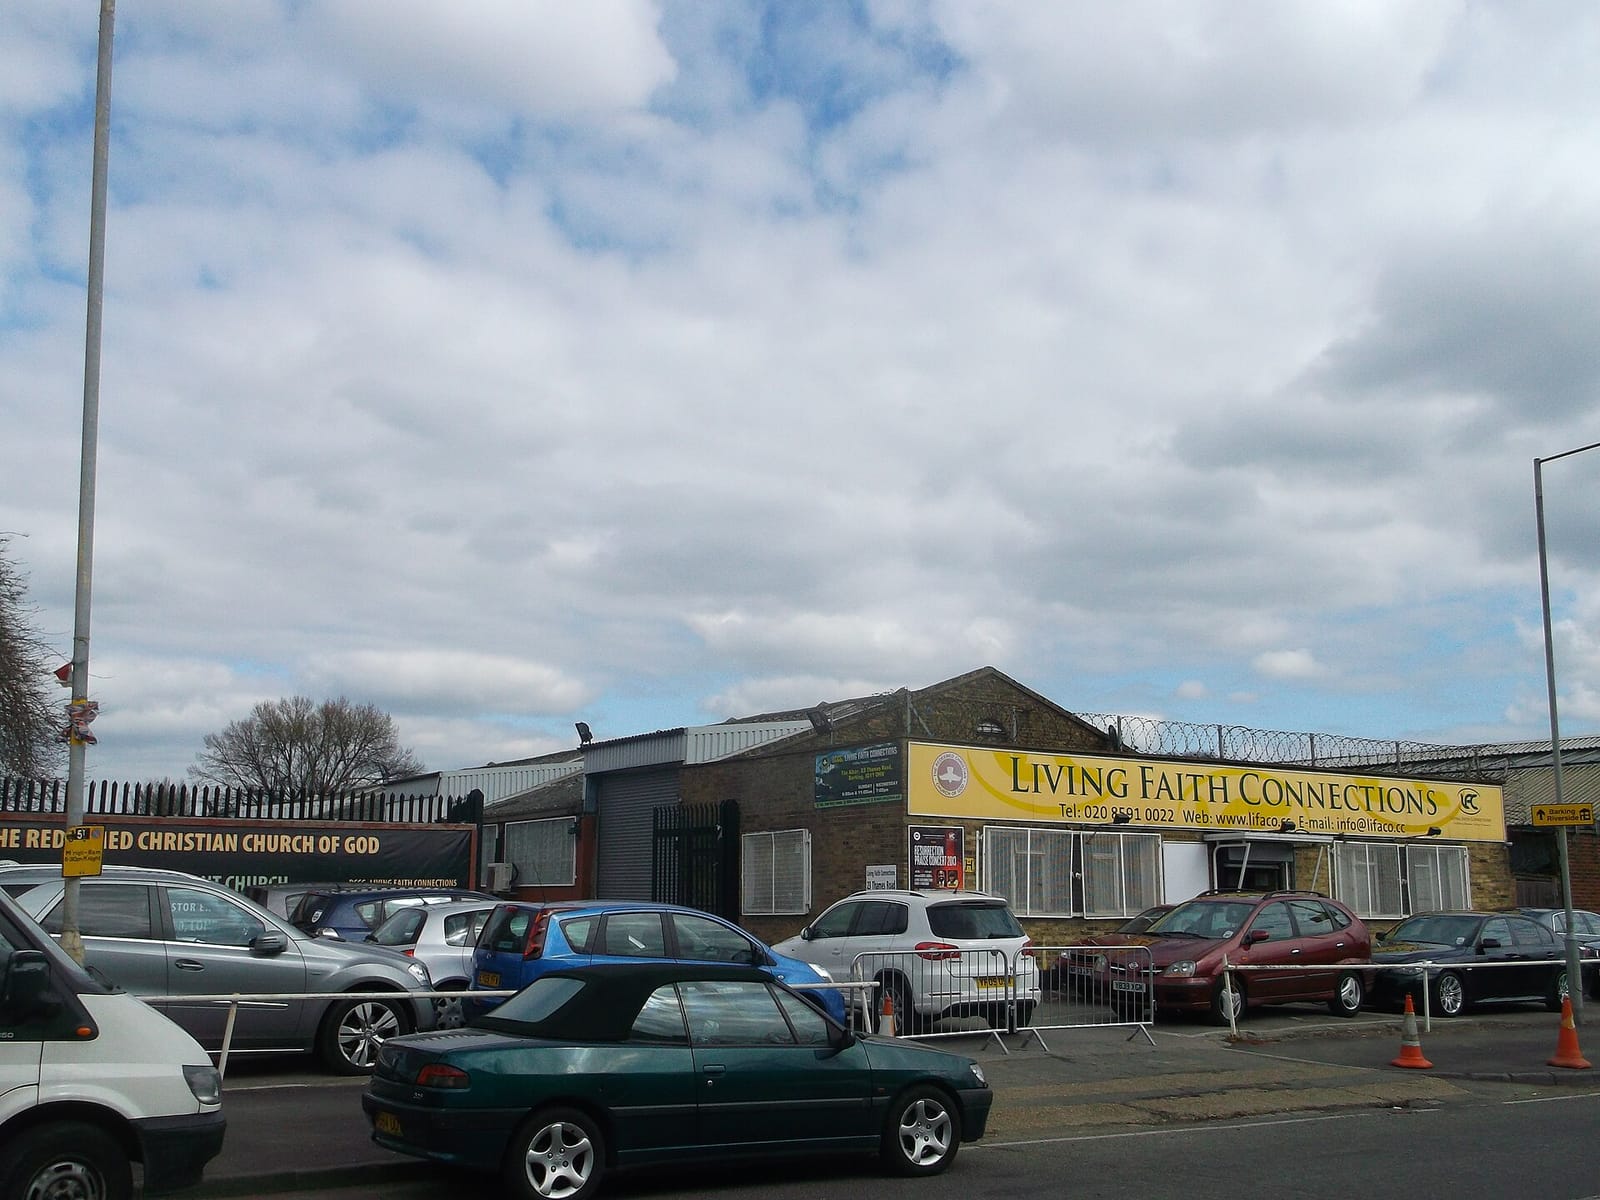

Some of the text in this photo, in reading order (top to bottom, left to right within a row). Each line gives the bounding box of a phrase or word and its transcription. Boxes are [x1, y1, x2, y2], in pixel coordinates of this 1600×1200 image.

[844, 753, 857, 762] LIVING
[858, 751, 869, 760] FAITH
[870, 746, 898, 758] CONNECTIONS
[1010, 757, 1438, 816] LIVING FAITH CONNECTIONS
[1059, 803, 1081, 818] Tel:
[1084, 805, 1108, 820] 020
[1145, 808, 1174, 823] 0022
[1183, 809, 1213, 824] Web:
[1299, 815, 1335, 830] E-mail:
[1336, 817, 1405, 833] info@lifaco.cc
[1549, 808, 1576, 816] Barking
[0, 828, 21, 848] HE
[137, 831, 238, 852] CHRISTIAN
[242, 834, 315, 853] CHURCH
[318, 835, 340, 854] OF
[344, 836, 380, 855] GOD
[914, 844, 944, 856] RESURRECTION
[914, 855, 929, 867] PRAISE
[929, 855, 947, 867] CONCERT
[965, 858, 974, 873] H
[393, 879, 413, 887] FAITH
[414, 878, 458, 888] CONNECTIONS
[872, 880, 885, 890] Thames
[886, 880, 895, 890] Road
